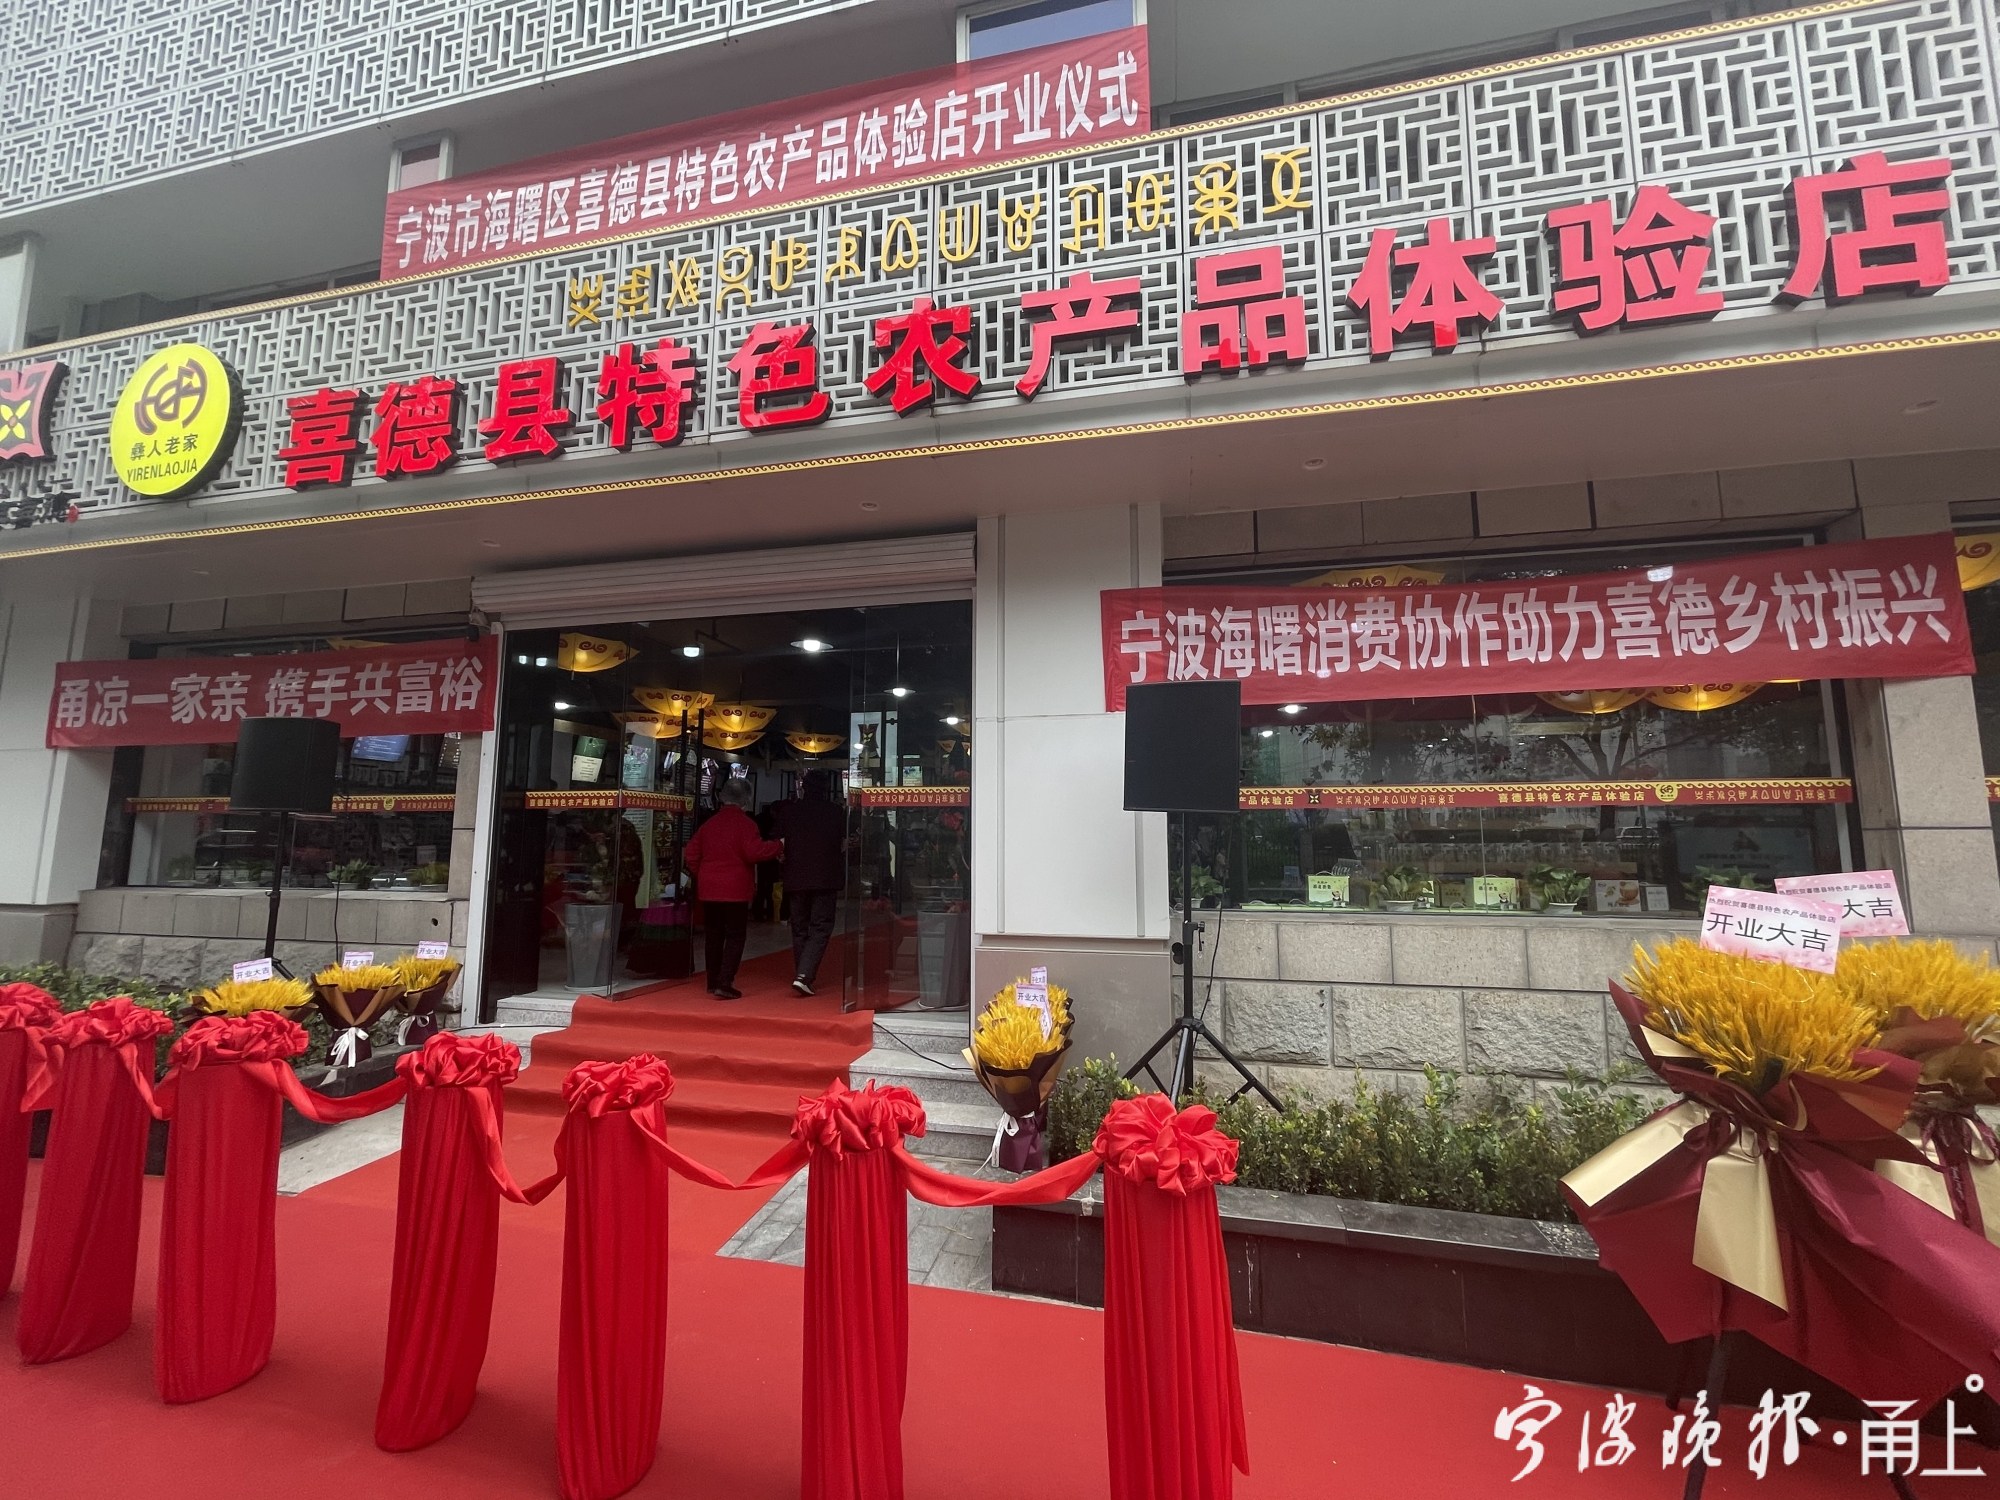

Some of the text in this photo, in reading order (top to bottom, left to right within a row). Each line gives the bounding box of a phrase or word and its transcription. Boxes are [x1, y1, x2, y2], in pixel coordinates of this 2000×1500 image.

[394, 48, 1139, 270] 宁波市海曙区喜德县特色农产品体验店开业仪式
[278, 153, 1950, 490] 喜德县特色农产品体验店
[129, 433, 199, 461] 彝人老家
[126, 458, 198, 483] YIRENLAOJIA
[1118, 563, 1953, 684] 宁波海曙消费协作助力喜德乡村振兴
[56, 657, 484, 728] 甬凉一家亲 携手共富裕
[1497, 790, 1646, 804] 喜德县特色农产品体验店
[1706, 911, 1832, 953] 开业大吉
[236, 966, 270, 979] 开业大吉
